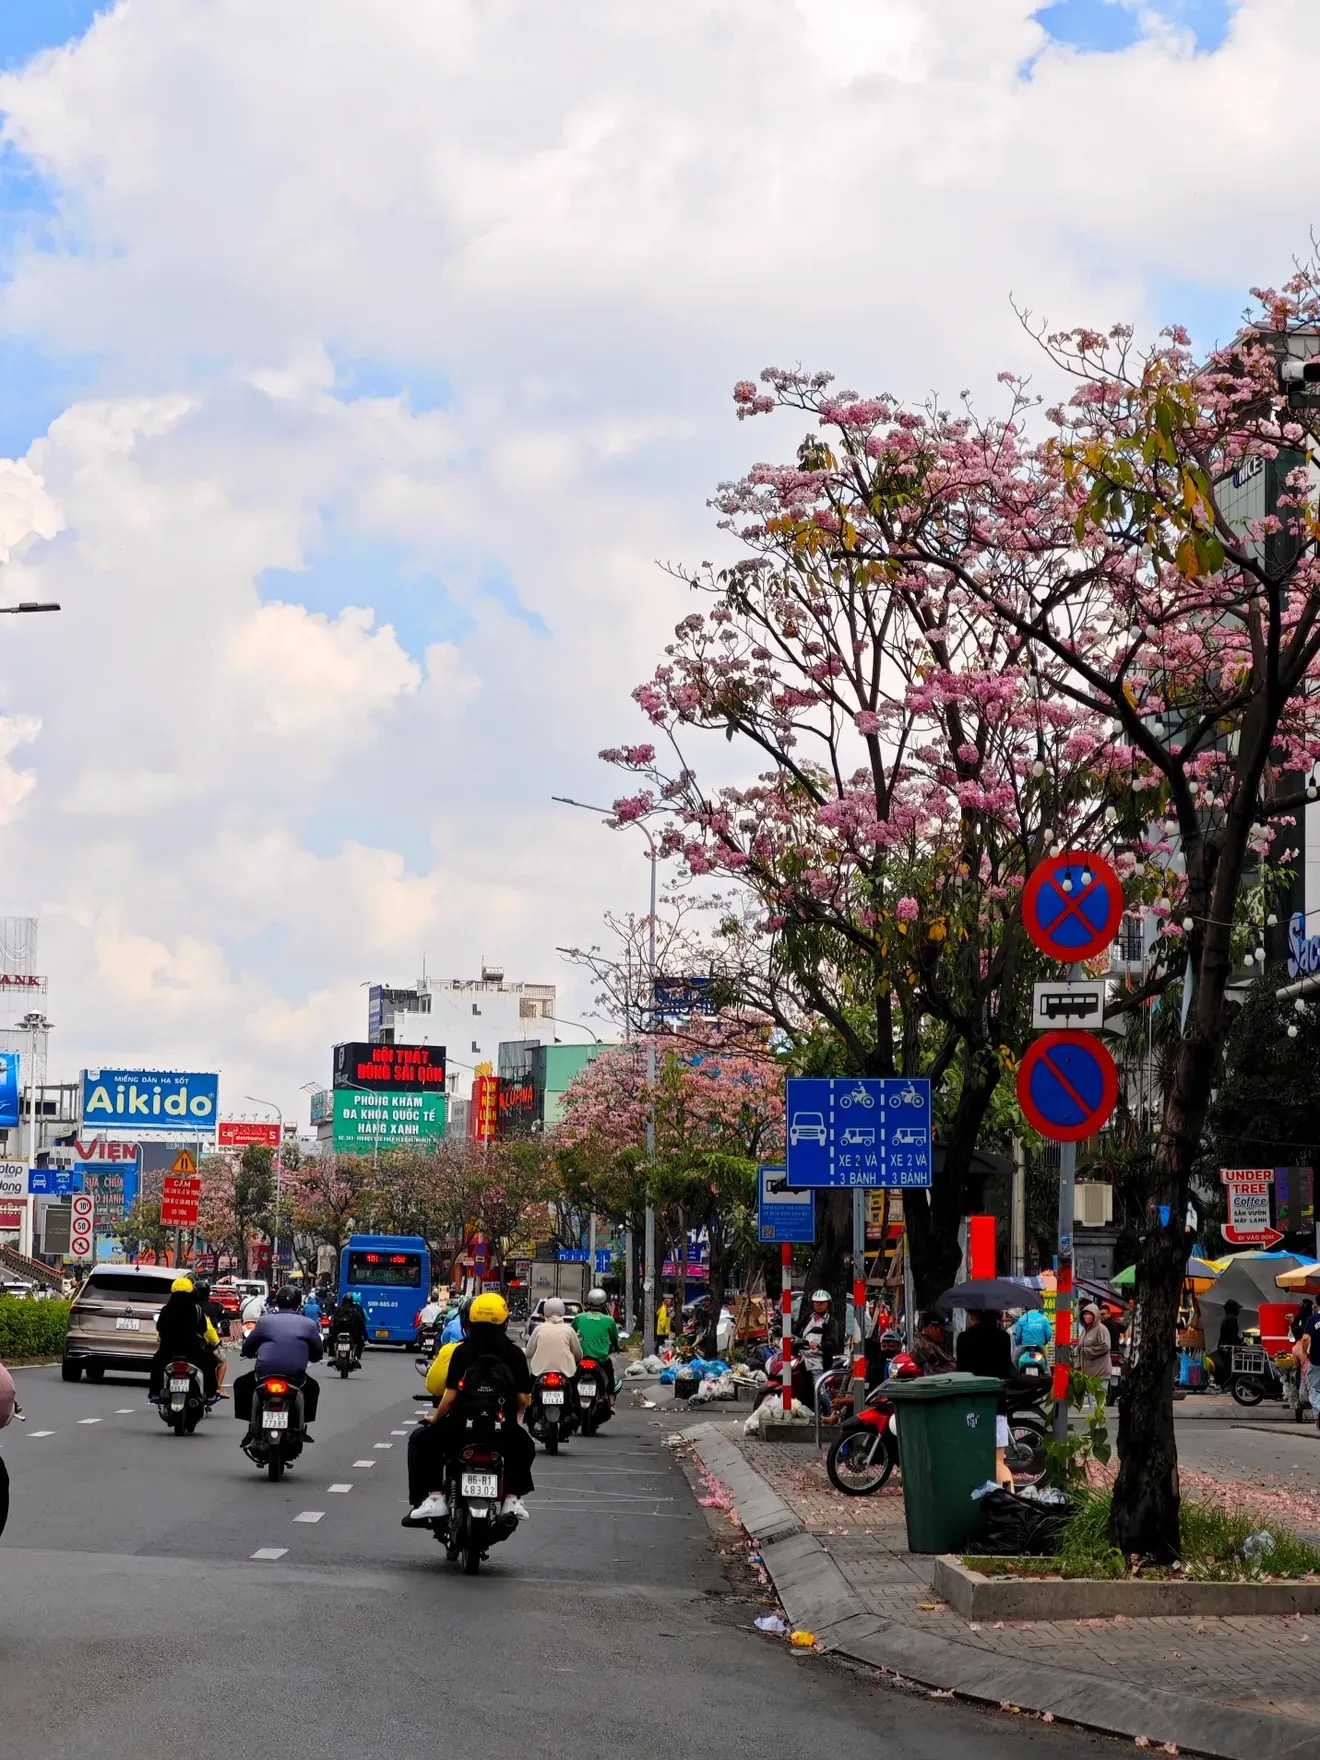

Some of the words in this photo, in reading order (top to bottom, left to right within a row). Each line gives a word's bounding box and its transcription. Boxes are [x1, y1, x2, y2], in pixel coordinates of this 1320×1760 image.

[372, 1046, 394, 1063] NỘI
[114, 1074, 139, 1083] MIẾNG
[86, 1085, 212, 1117] Aikido
[354, 1093, 389, 1106] PHÒNG
[391, 1094, 423, 1108] KHÁM
[343, 1109, 358, 1119] ĐA
[360, 1110, 389, 1120] KHOA
[392, 1106, 420, 1122] QUỐC
[423, 1108, 436, 1122] TẾ
[358, 1121, 387, 1134] HÀNG
[389, 1123, 419, 1135] XANH
[839, 1154, 852, 1167] XE
[855, 1154, 861, 1167] 2
[865, 1151, 878, 1167] VÀ
[890, 1154, 903, 1167] XE
[908, 1154, 913, 1167] 2
[915, 1151, 928, 1167] VÀ
[840, 1172, 846, 1185] 3
[850, 1168, 877, 1185] BÁNH
[892, 1172, 898, 1184] 3
[900, 1168, 928, 1185] BÁNH
[1226, 1171, 1272, 1180] UNDER
[1233, 1184, 1266, 1194] TREE
[1234, 1196, 1266, 1208] Coffee
[78, 1222, 86, 1230] 50
[468, 1476, 491, 1485] 86-B1
[464, 1486, 494, 1496] 483.02
